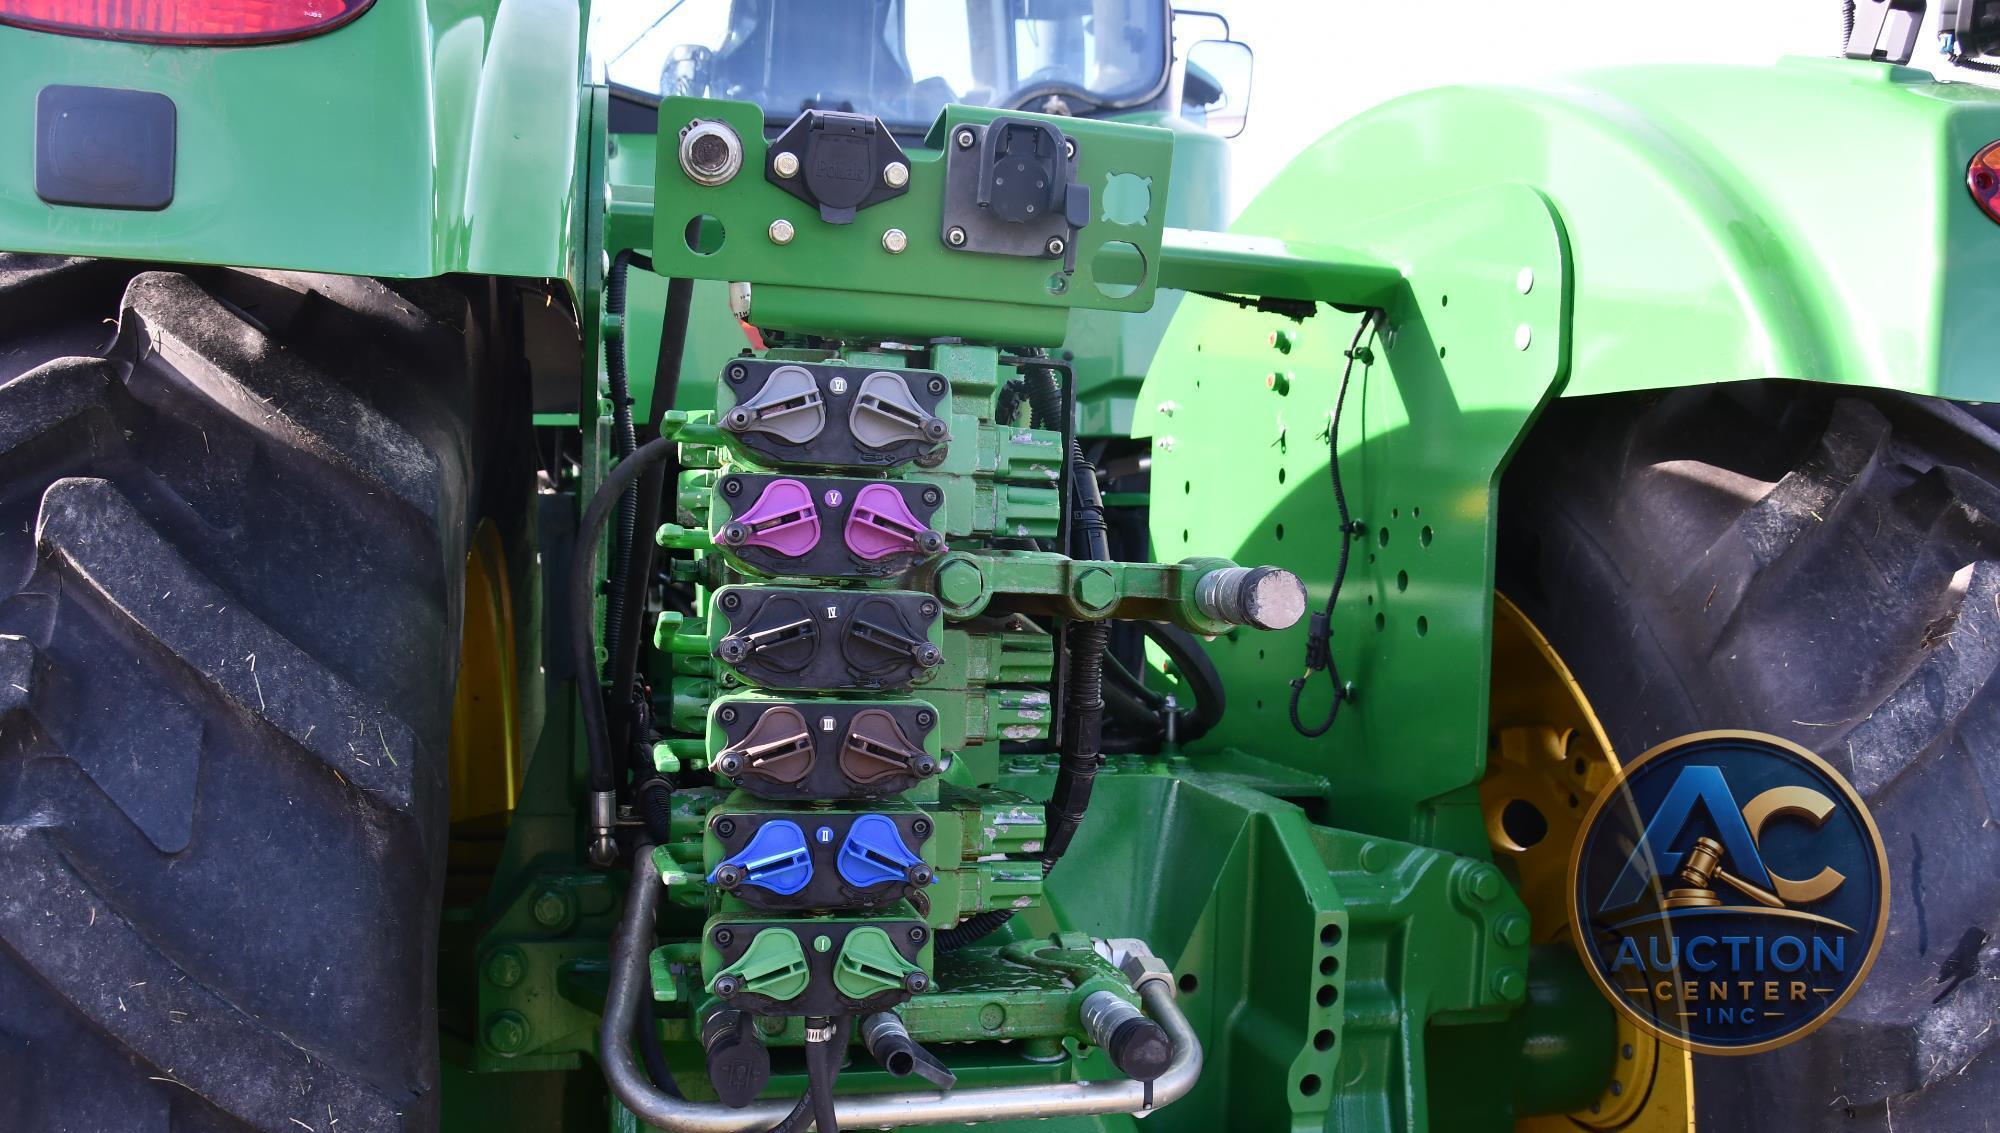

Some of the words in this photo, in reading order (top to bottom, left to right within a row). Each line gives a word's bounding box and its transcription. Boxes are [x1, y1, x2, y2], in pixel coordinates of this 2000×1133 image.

[833, 379, 844, 392] VI
[829, 492, 839, 505] V
[827, 606, 838, 619] IV
[823, 718, 834, 731] III
[821, 830, 829, 842] II
